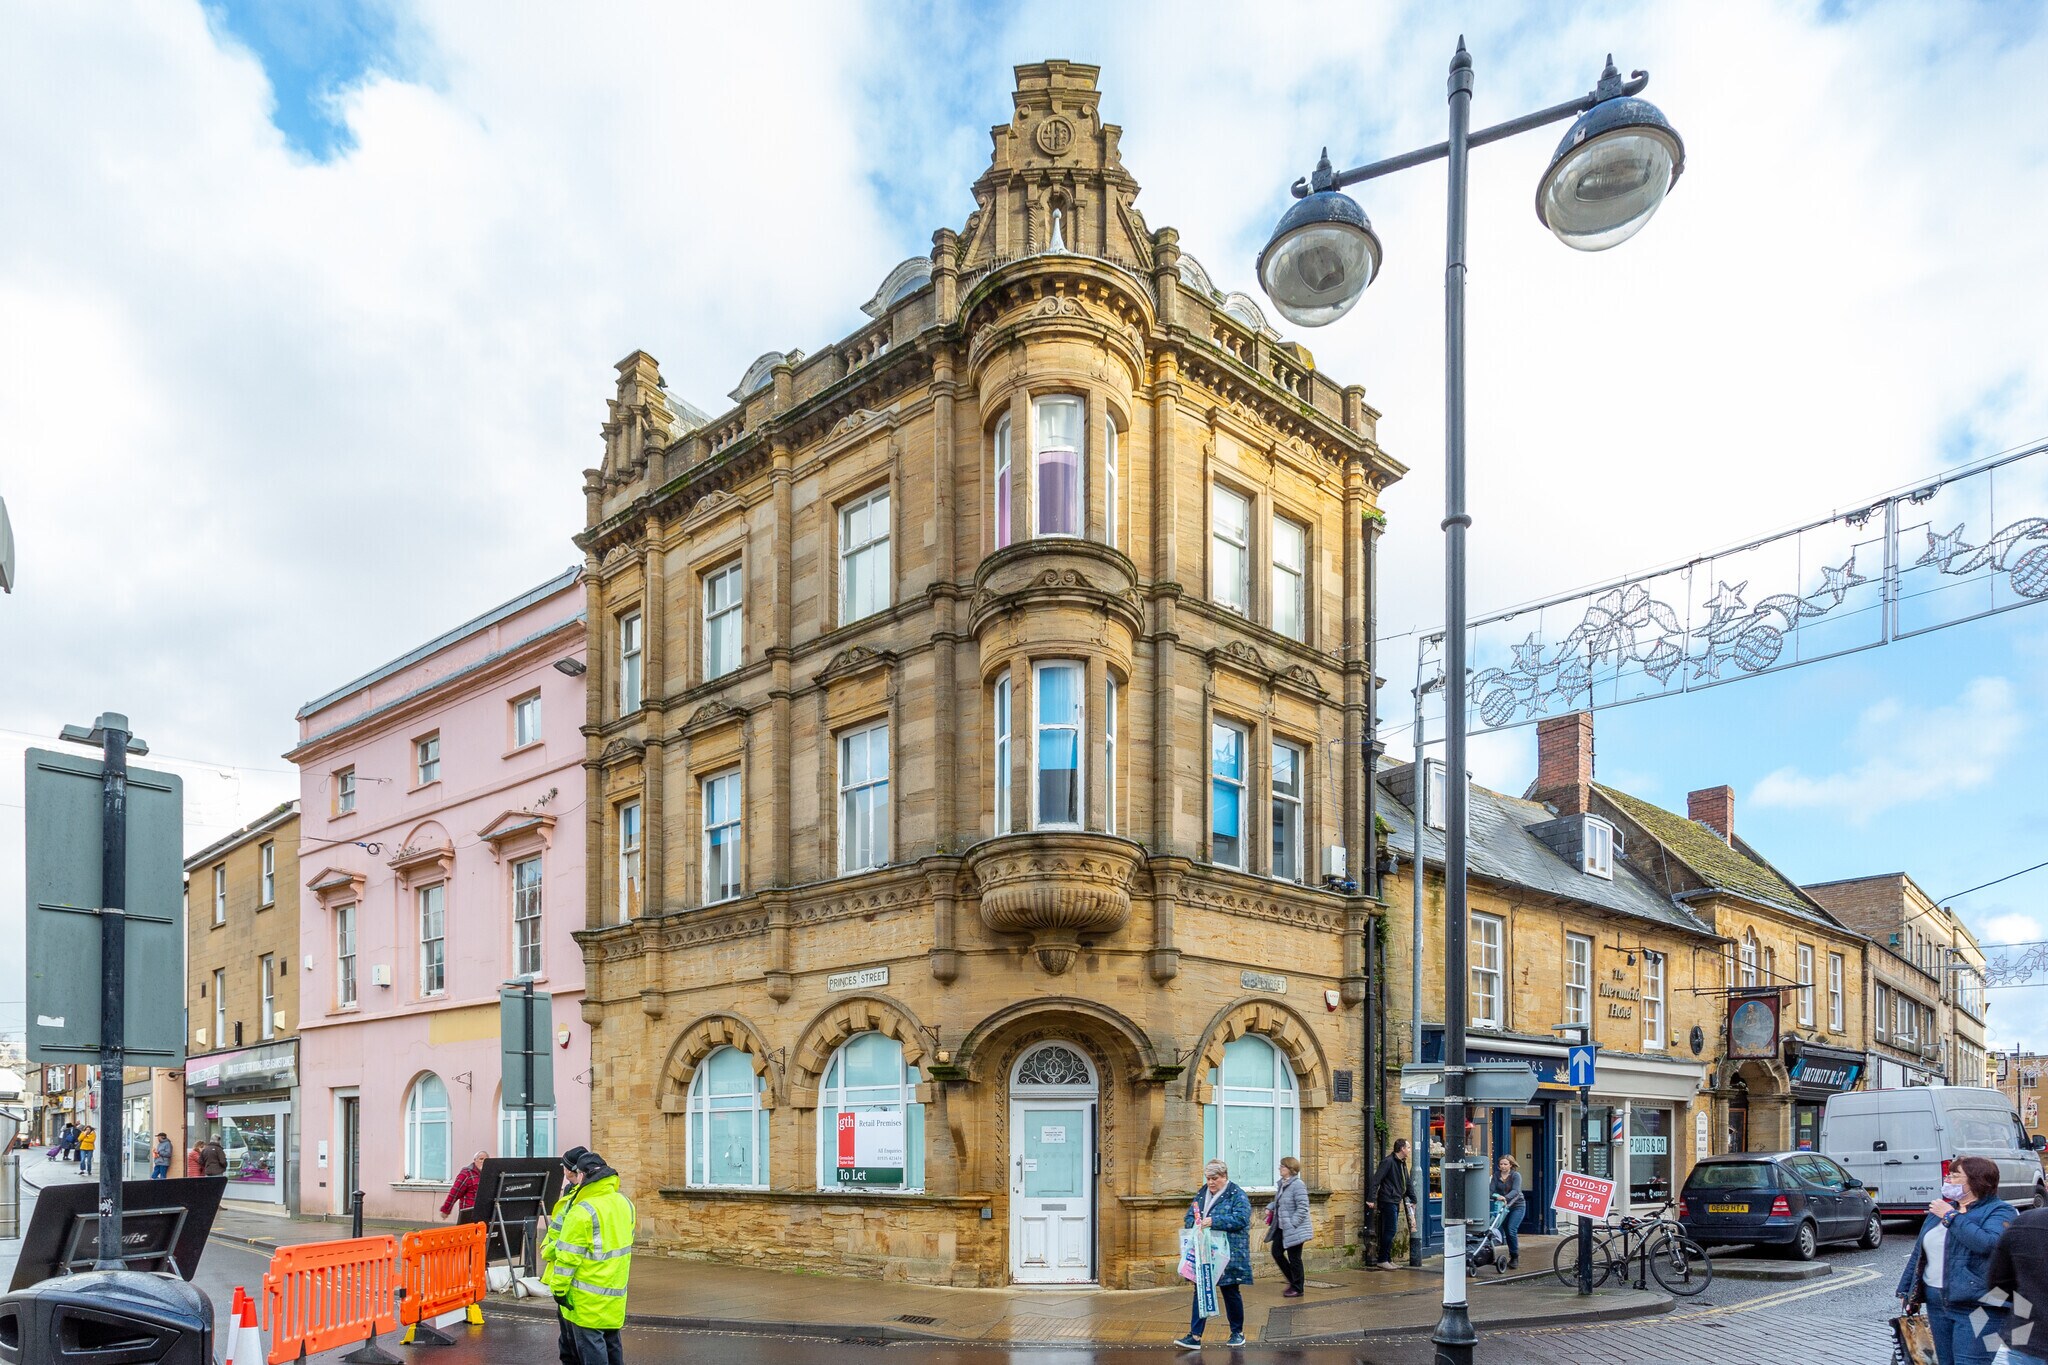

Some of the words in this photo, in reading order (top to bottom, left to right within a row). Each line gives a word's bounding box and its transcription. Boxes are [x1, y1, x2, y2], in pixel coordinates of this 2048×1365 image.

[829, 976, 857, 989] PRINCES
[860, 971, 886, 983] STREET
[1612, 968, 1625, 981] The
[1599, 983, 1641, 1002] Mermaid
[1608, 1003, 1631, 1019] Hotel
[1480, 1056, 1544, 1072] MORTRS
[1801, 1067, 1831, 1083] INFINITY
[839, 1115, 854, 1130] gth
[859, 1119, 875, 1127] Retail
[876, 1119, 902, 1127] Premises
[1635, 1138, 1650, 1152] CUTS
[1651, 1138, 1656, 1152] &
[839, 1169, 850, 1180] To
[852, 1169, 866, 1180] Let
[1565, 1177, 1608, 1193] COVID-19
[1565, 1189, 1585, 1202] Stay
[1586, 1194, 1601, 1204] 2m
[1568, 1200, 1592, 1211] apart
[1204, 1264, 1213, 1291] Factory
[1206, 1293, 1214, 1311] Card
